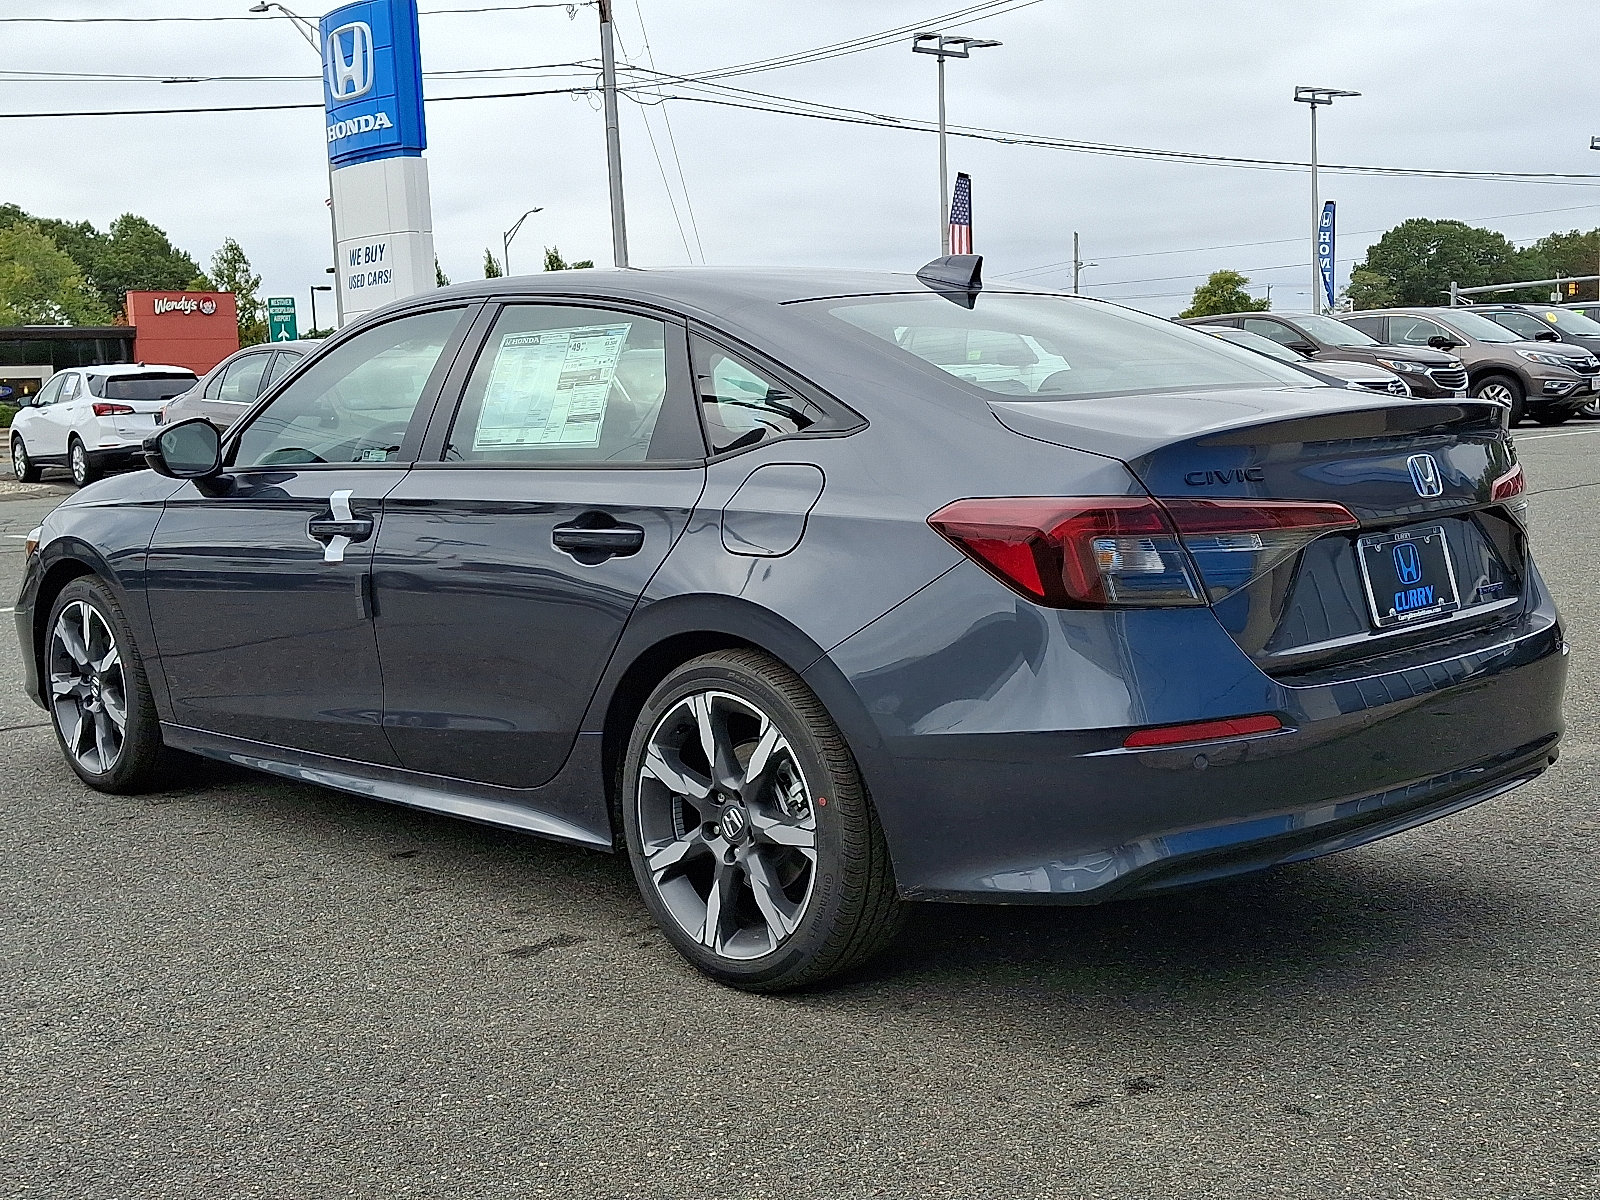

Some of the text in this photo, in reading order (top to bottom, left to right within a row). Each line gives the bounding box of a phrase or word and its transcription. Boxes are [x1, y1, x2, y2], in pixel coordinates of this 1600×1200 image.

[327, 112, 393, 143] HONDA
[349, 243, 386, 267] WE BUY
[348, 269, 392, 290] USED CARS!
[154, 296, 198, 315] Wendy's
[511, 337, 540, 345] HONDA
[1184, 466, 1265, 486] CIVIC
[1394, 585, 1434, 611] CURRY
